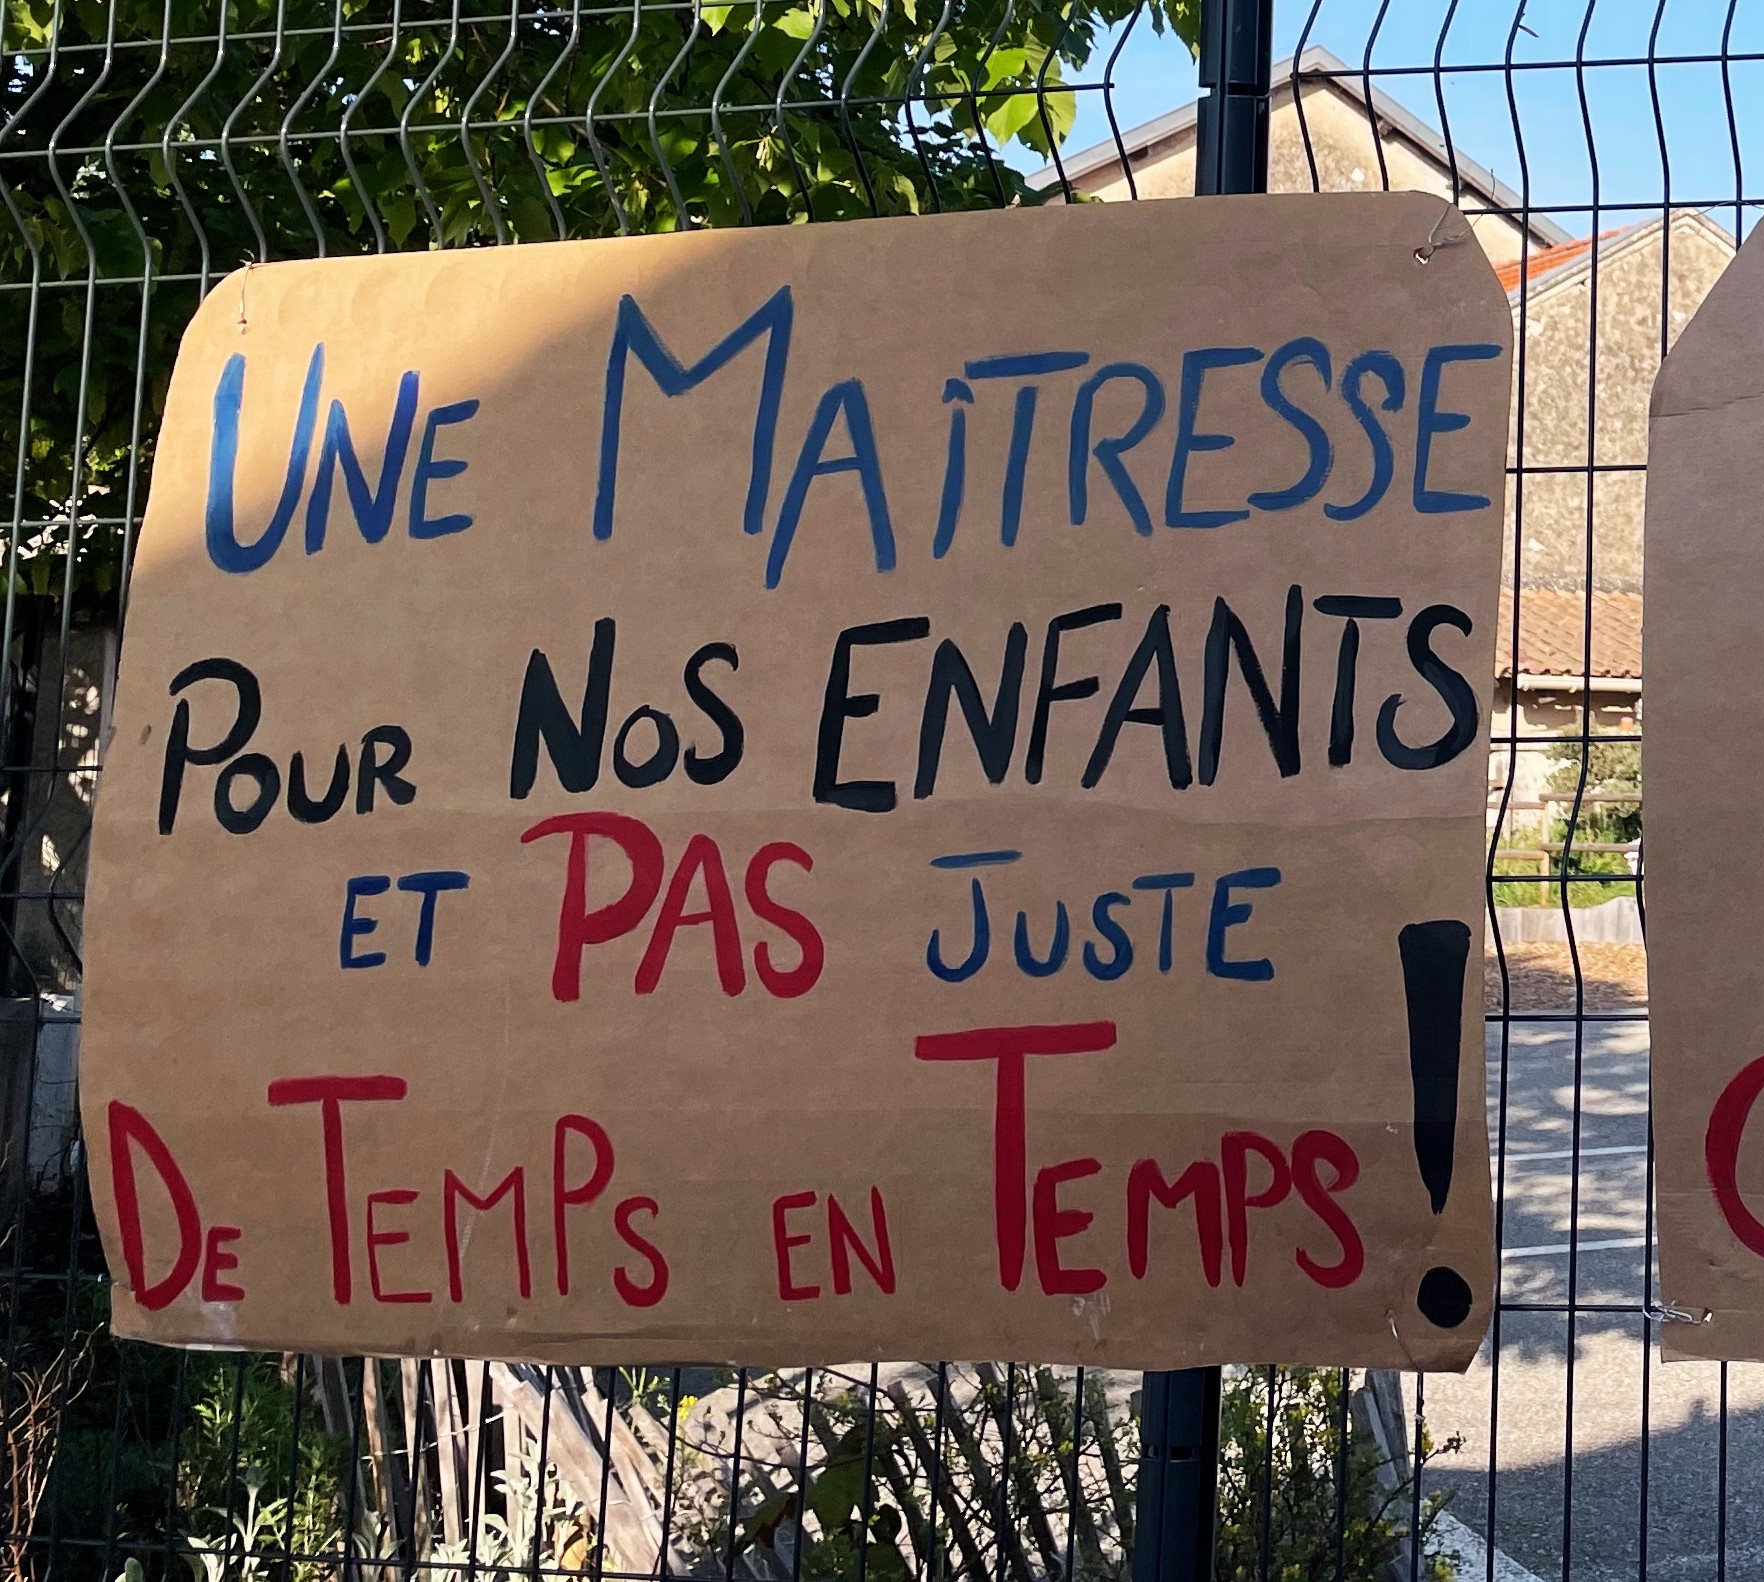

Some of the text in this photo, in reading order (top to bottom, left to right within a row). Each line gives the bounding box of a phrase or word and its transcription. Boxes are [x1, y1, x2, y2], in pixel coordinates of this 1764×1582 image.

[812, 584, 1479, 812] ENFANTS
[339, 871, 471, 969] ET
[520, 811, 824, 1002] PAS
[772, 1185, 895, 1301] EN
